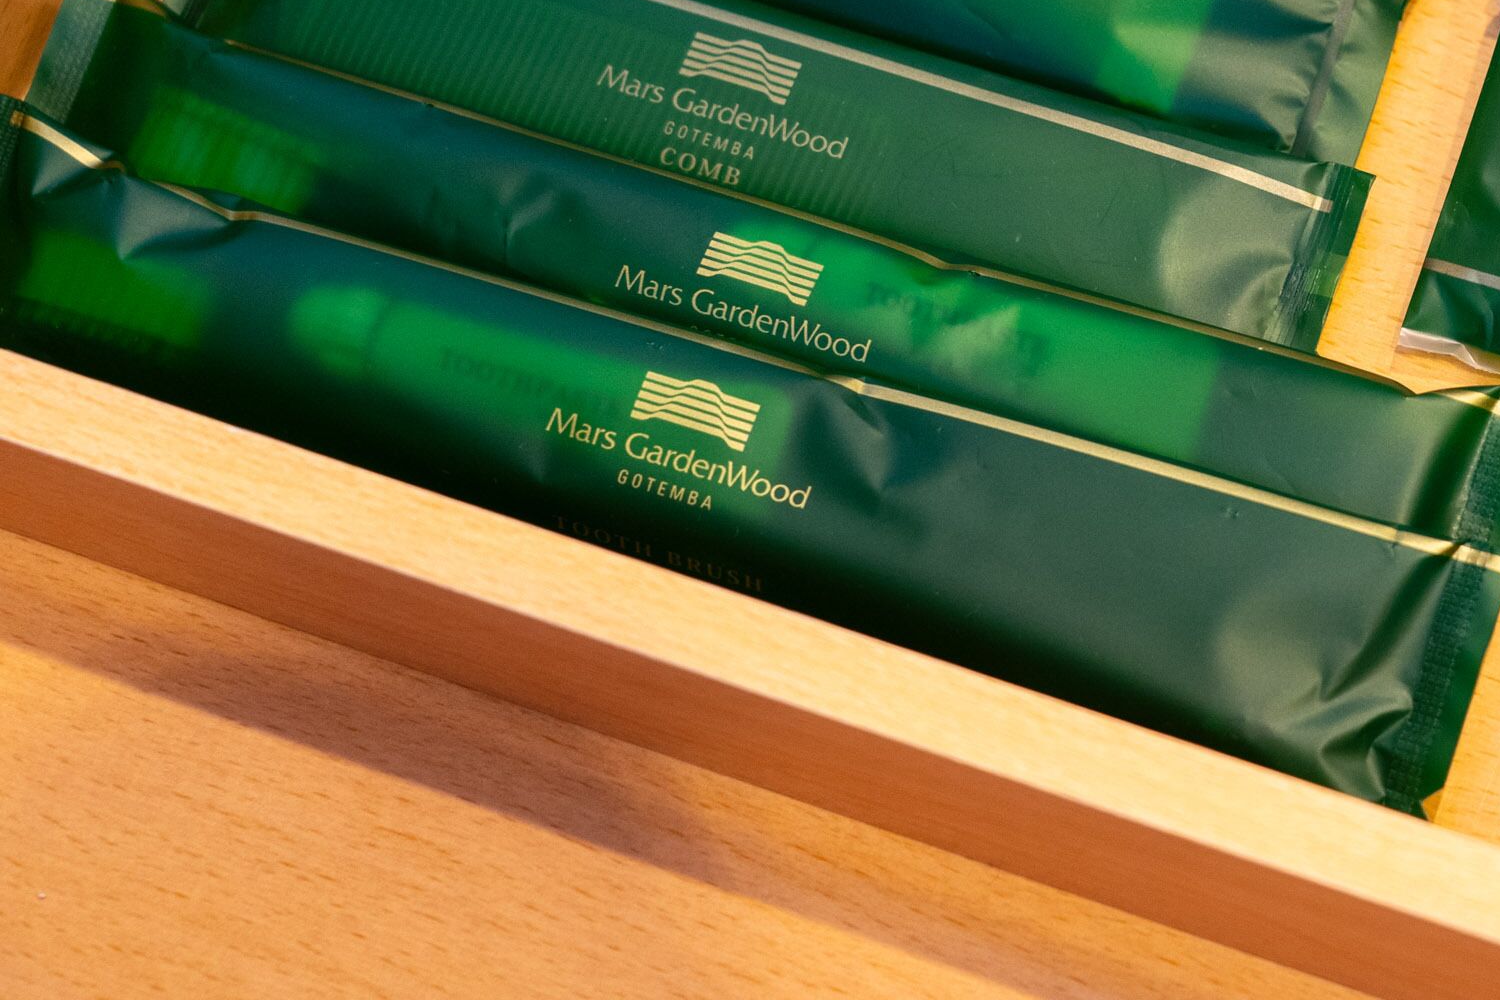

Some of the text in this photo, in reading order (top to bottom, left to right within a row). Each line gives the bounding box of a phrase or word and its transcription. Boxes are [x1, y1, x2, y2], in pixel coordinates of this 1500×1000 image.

[596, 63, 849, 160] Mars GardenWood
[663, 120, 755, 161] GOTEMBA
[659, 146, 742, 187] COMB
[614, 263, 683, 307] Mars
[690, 288, 873, 364] GardenWood
[545, 406, 813, 510] Mars GardenWood
[616, 468, 714, 511] GOTEMBA
[552, 513, 767, 593] TOOTH BRUSH
